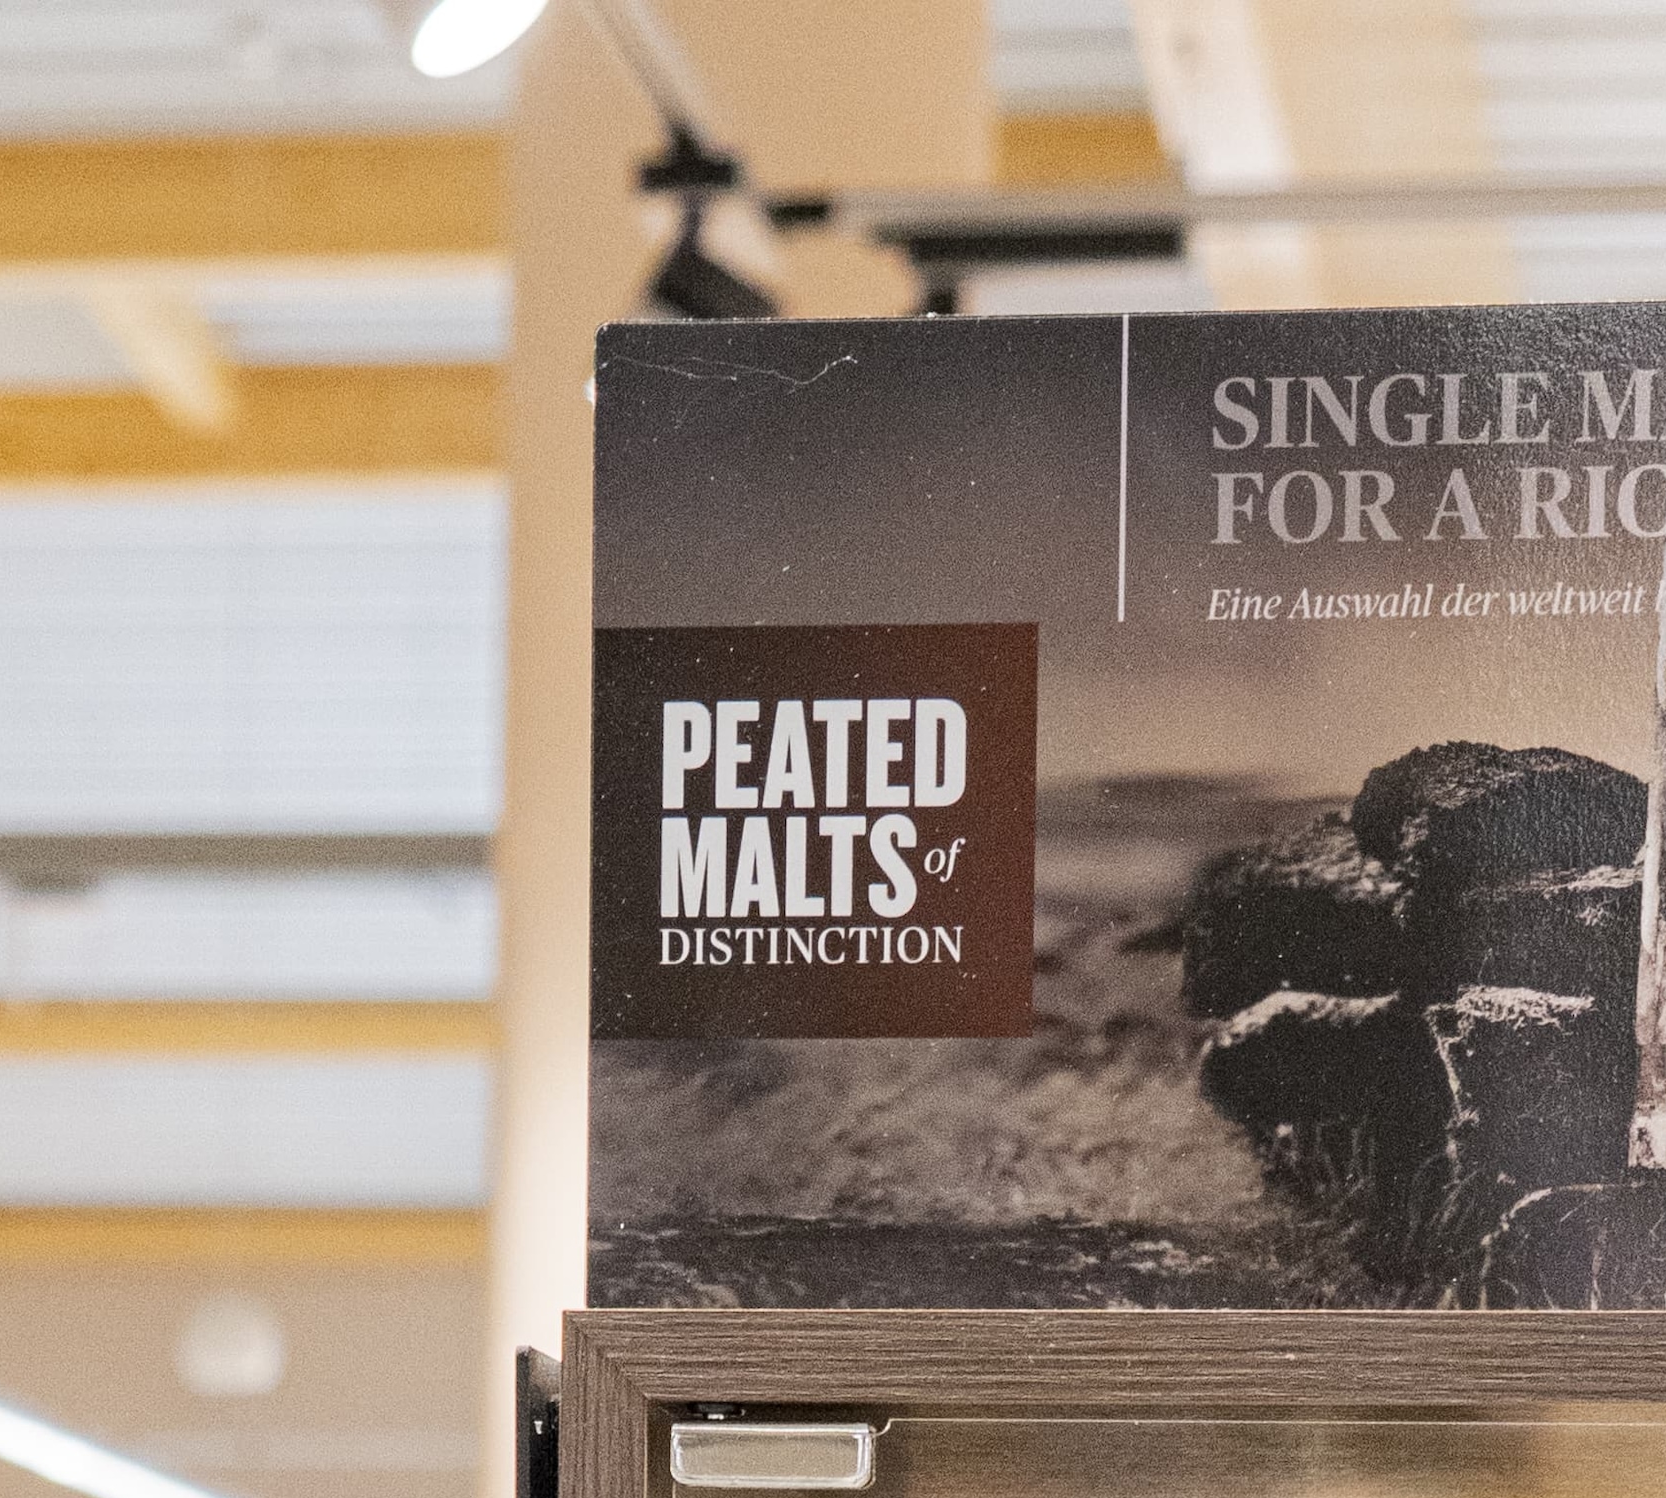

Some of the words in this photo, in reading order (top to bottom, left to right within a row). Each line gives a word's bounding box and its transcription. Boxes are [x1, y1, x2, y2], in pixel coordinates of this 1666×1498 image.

[1211, 372, 1550, 450] SINGLE
[1211, 469, 1402, 544] FOR
[1424, 468, 1487, 540] A
[1207, 588, 1282, 621] Eine
[1289, 583, 1432, 620] Auswahl
[1442, 584, 1497, 616] der
[1510, 582, 1644, 616] weltweit
[662, 699, 966, 809] PEATED
[660, 814, 917, 918] MALTS
[924, 838, 966, 882] of
[659, 926, 964, 965] DISTINCTION
